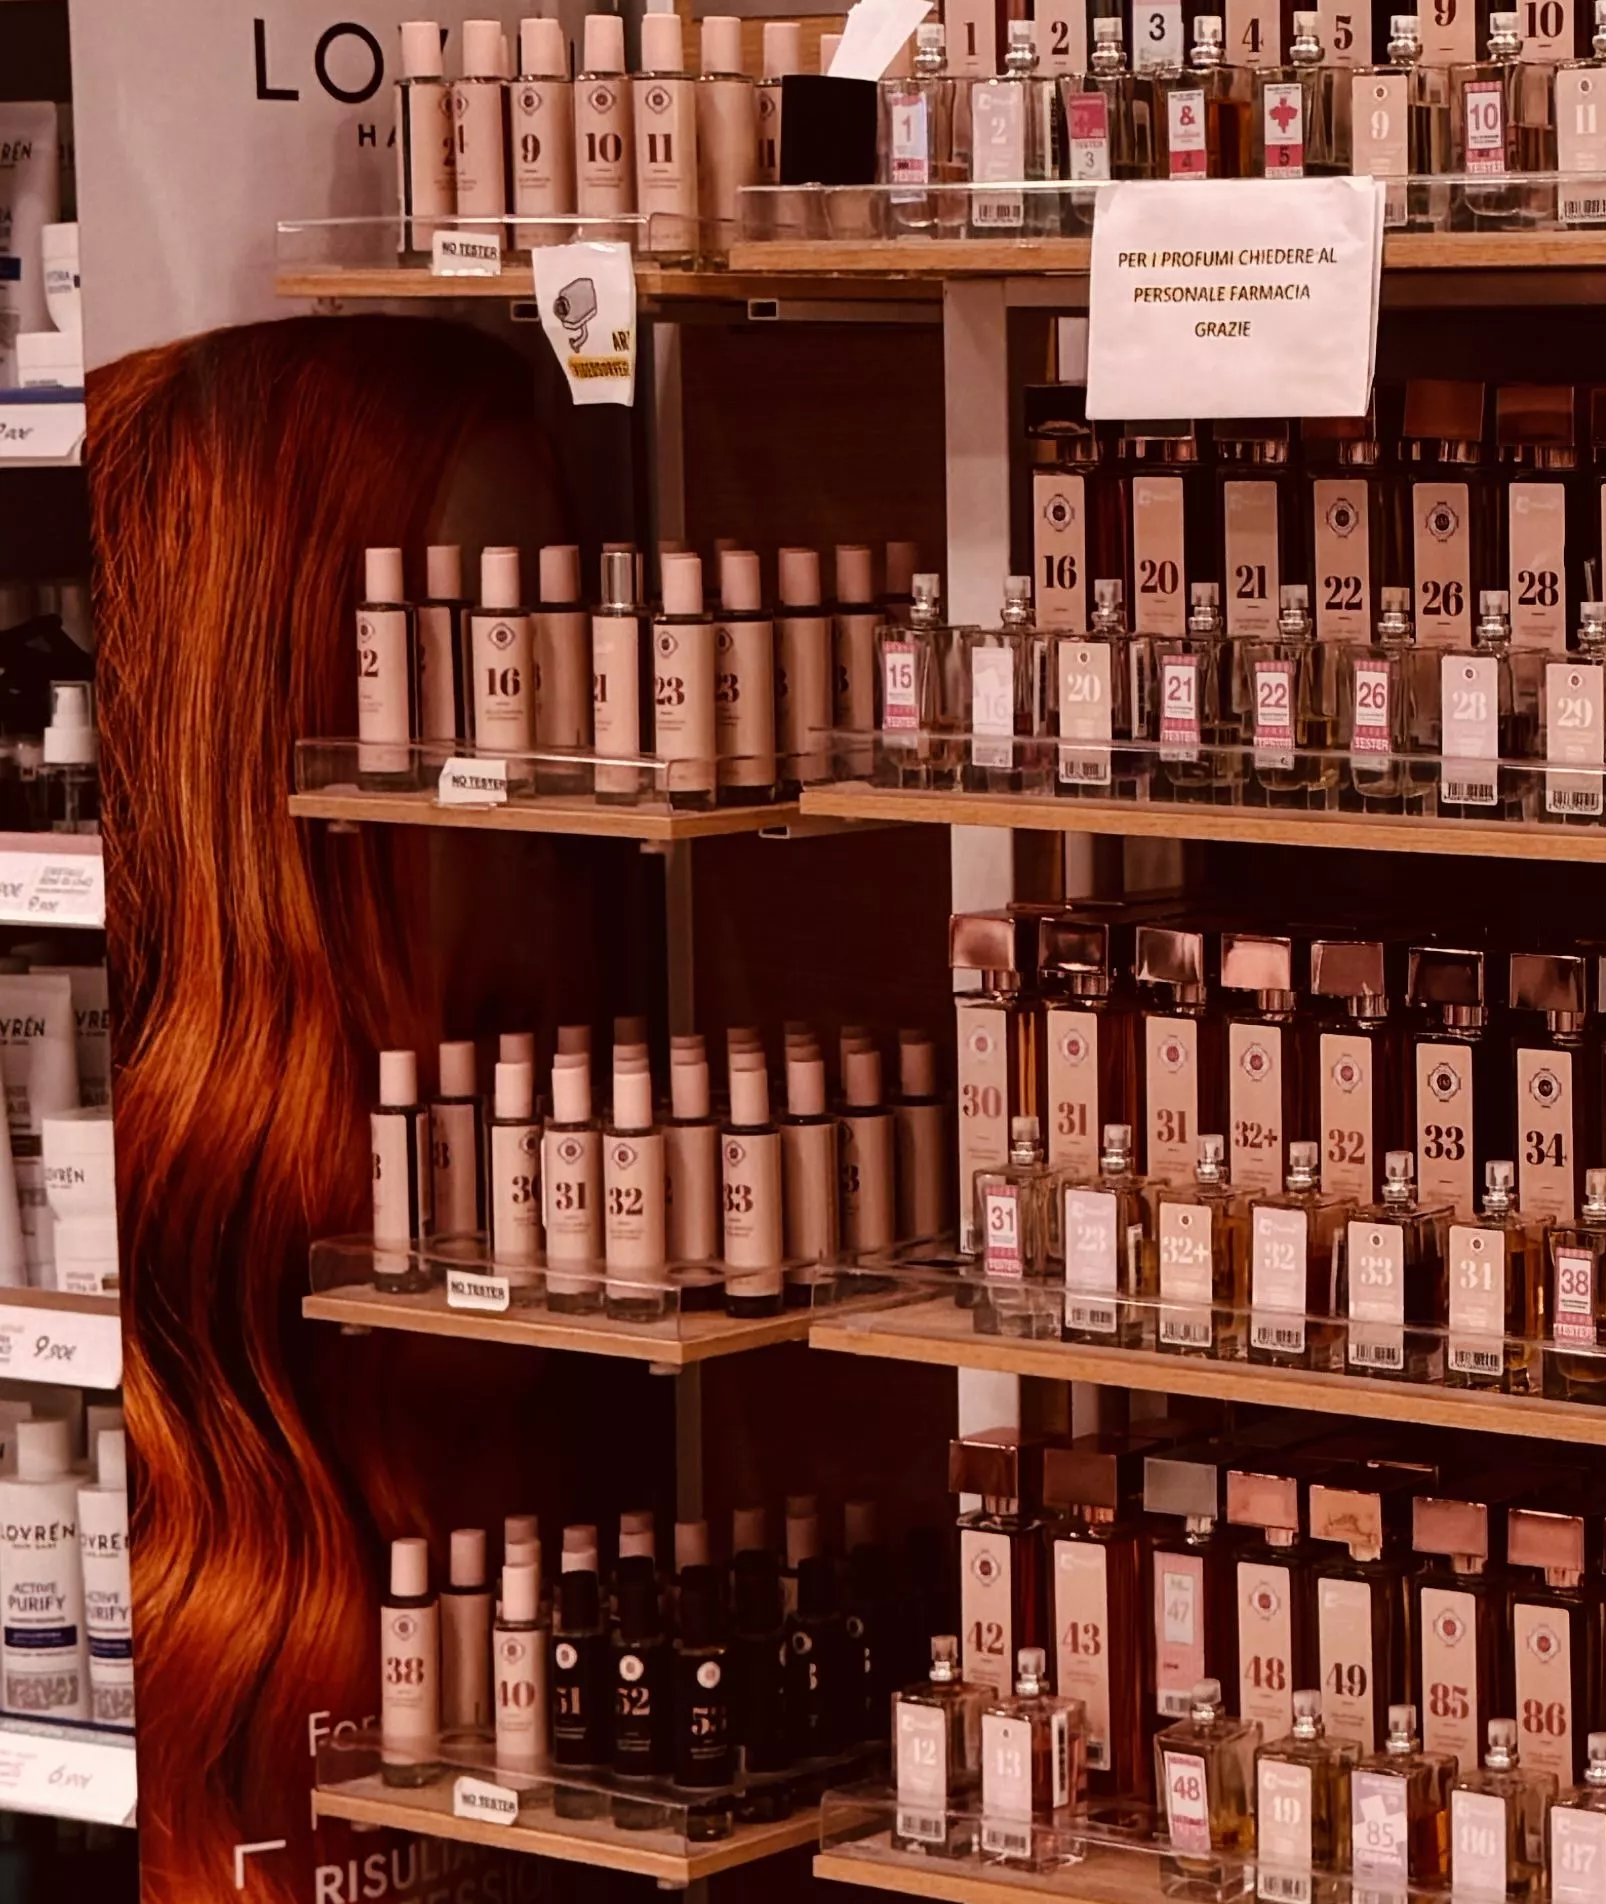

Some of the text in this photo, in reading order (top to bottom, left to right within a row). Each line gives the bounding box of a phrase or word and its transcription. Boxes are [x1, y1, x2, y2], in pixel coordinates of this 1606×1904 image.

[1242, 18, 1264, 53] 4
[1333, 15, 1353, 50] 5
[1524, 1, 1564, 39] 10
[964, 21, 977, 57] 1
[585, 133, 623, 164] 10
[442, 242, 497, 260] NO TESTER
[1118, 247, 1337, 268] PER I PROFUMI CHIEDERE AL
[1134, 284, 1311, 303] PERSONALE FARMACIA
[1195, 321, 1251, 338] GRAZIE
[1043, 555, 1077, 590] 16
[1236, 564, 1267, 599] 21
[1422, 580, 1464, 616] 26
[1058, 1102, 1087, 1136] 31
[1526, 1130, 1568, 1167] 34
[967, 1621, 1005, 1657] 42
[386, 1656, 425, 1685] 38
[1246, 1656, 1286, 1692] 48
[1430, 1683, 1470, 1720] 85
